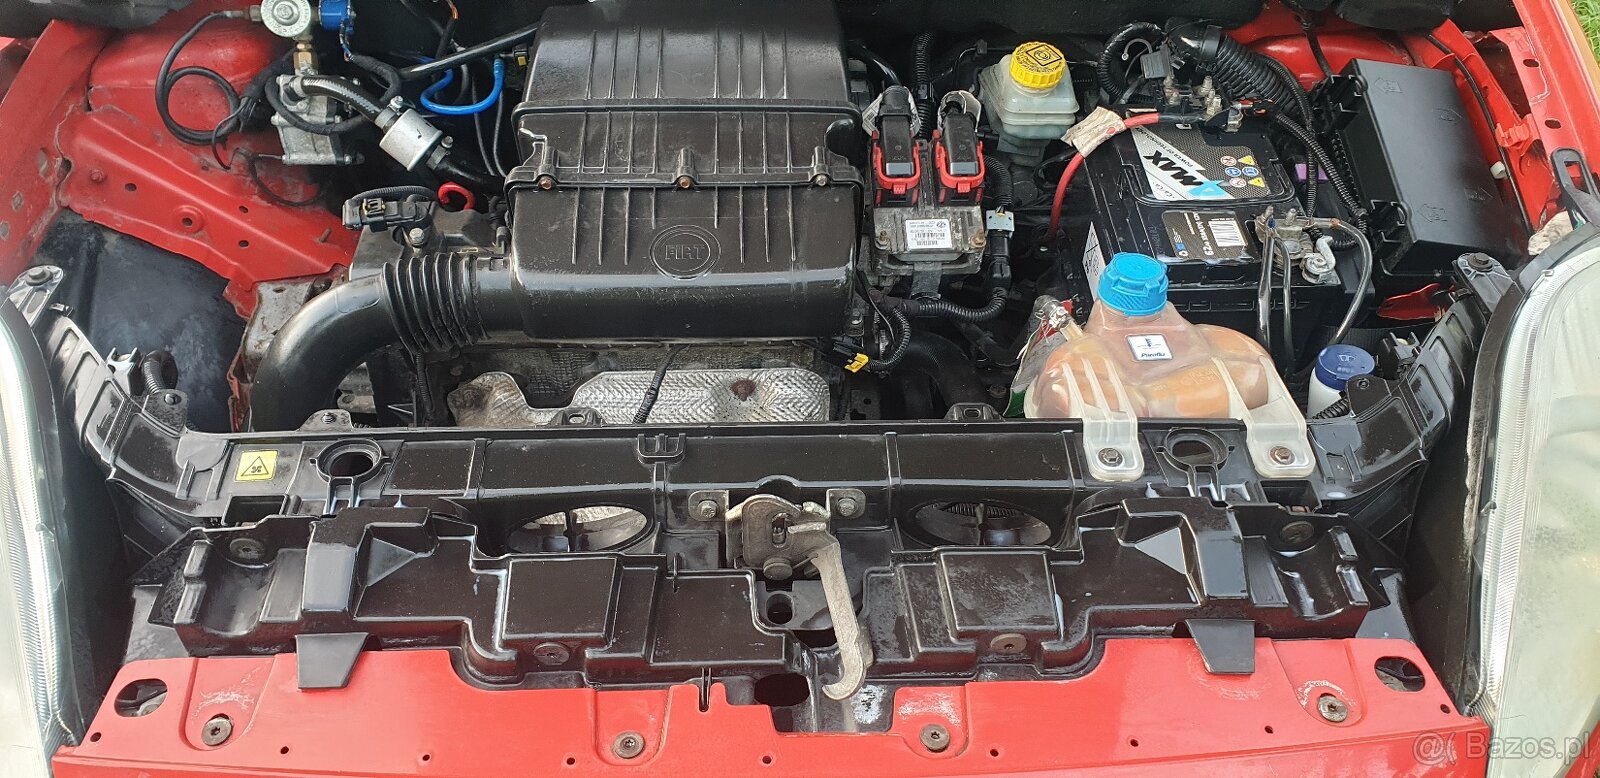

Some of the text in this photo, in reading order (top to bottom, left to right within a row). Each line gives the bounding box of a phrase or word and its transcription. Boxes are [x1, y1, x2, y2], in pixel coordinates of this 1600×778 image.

[1135, 127, 1167, 149] TECHNOLOGY
[1174, 153, 1194, 167] POWER
[665, 244, 706, 260] FIAT
